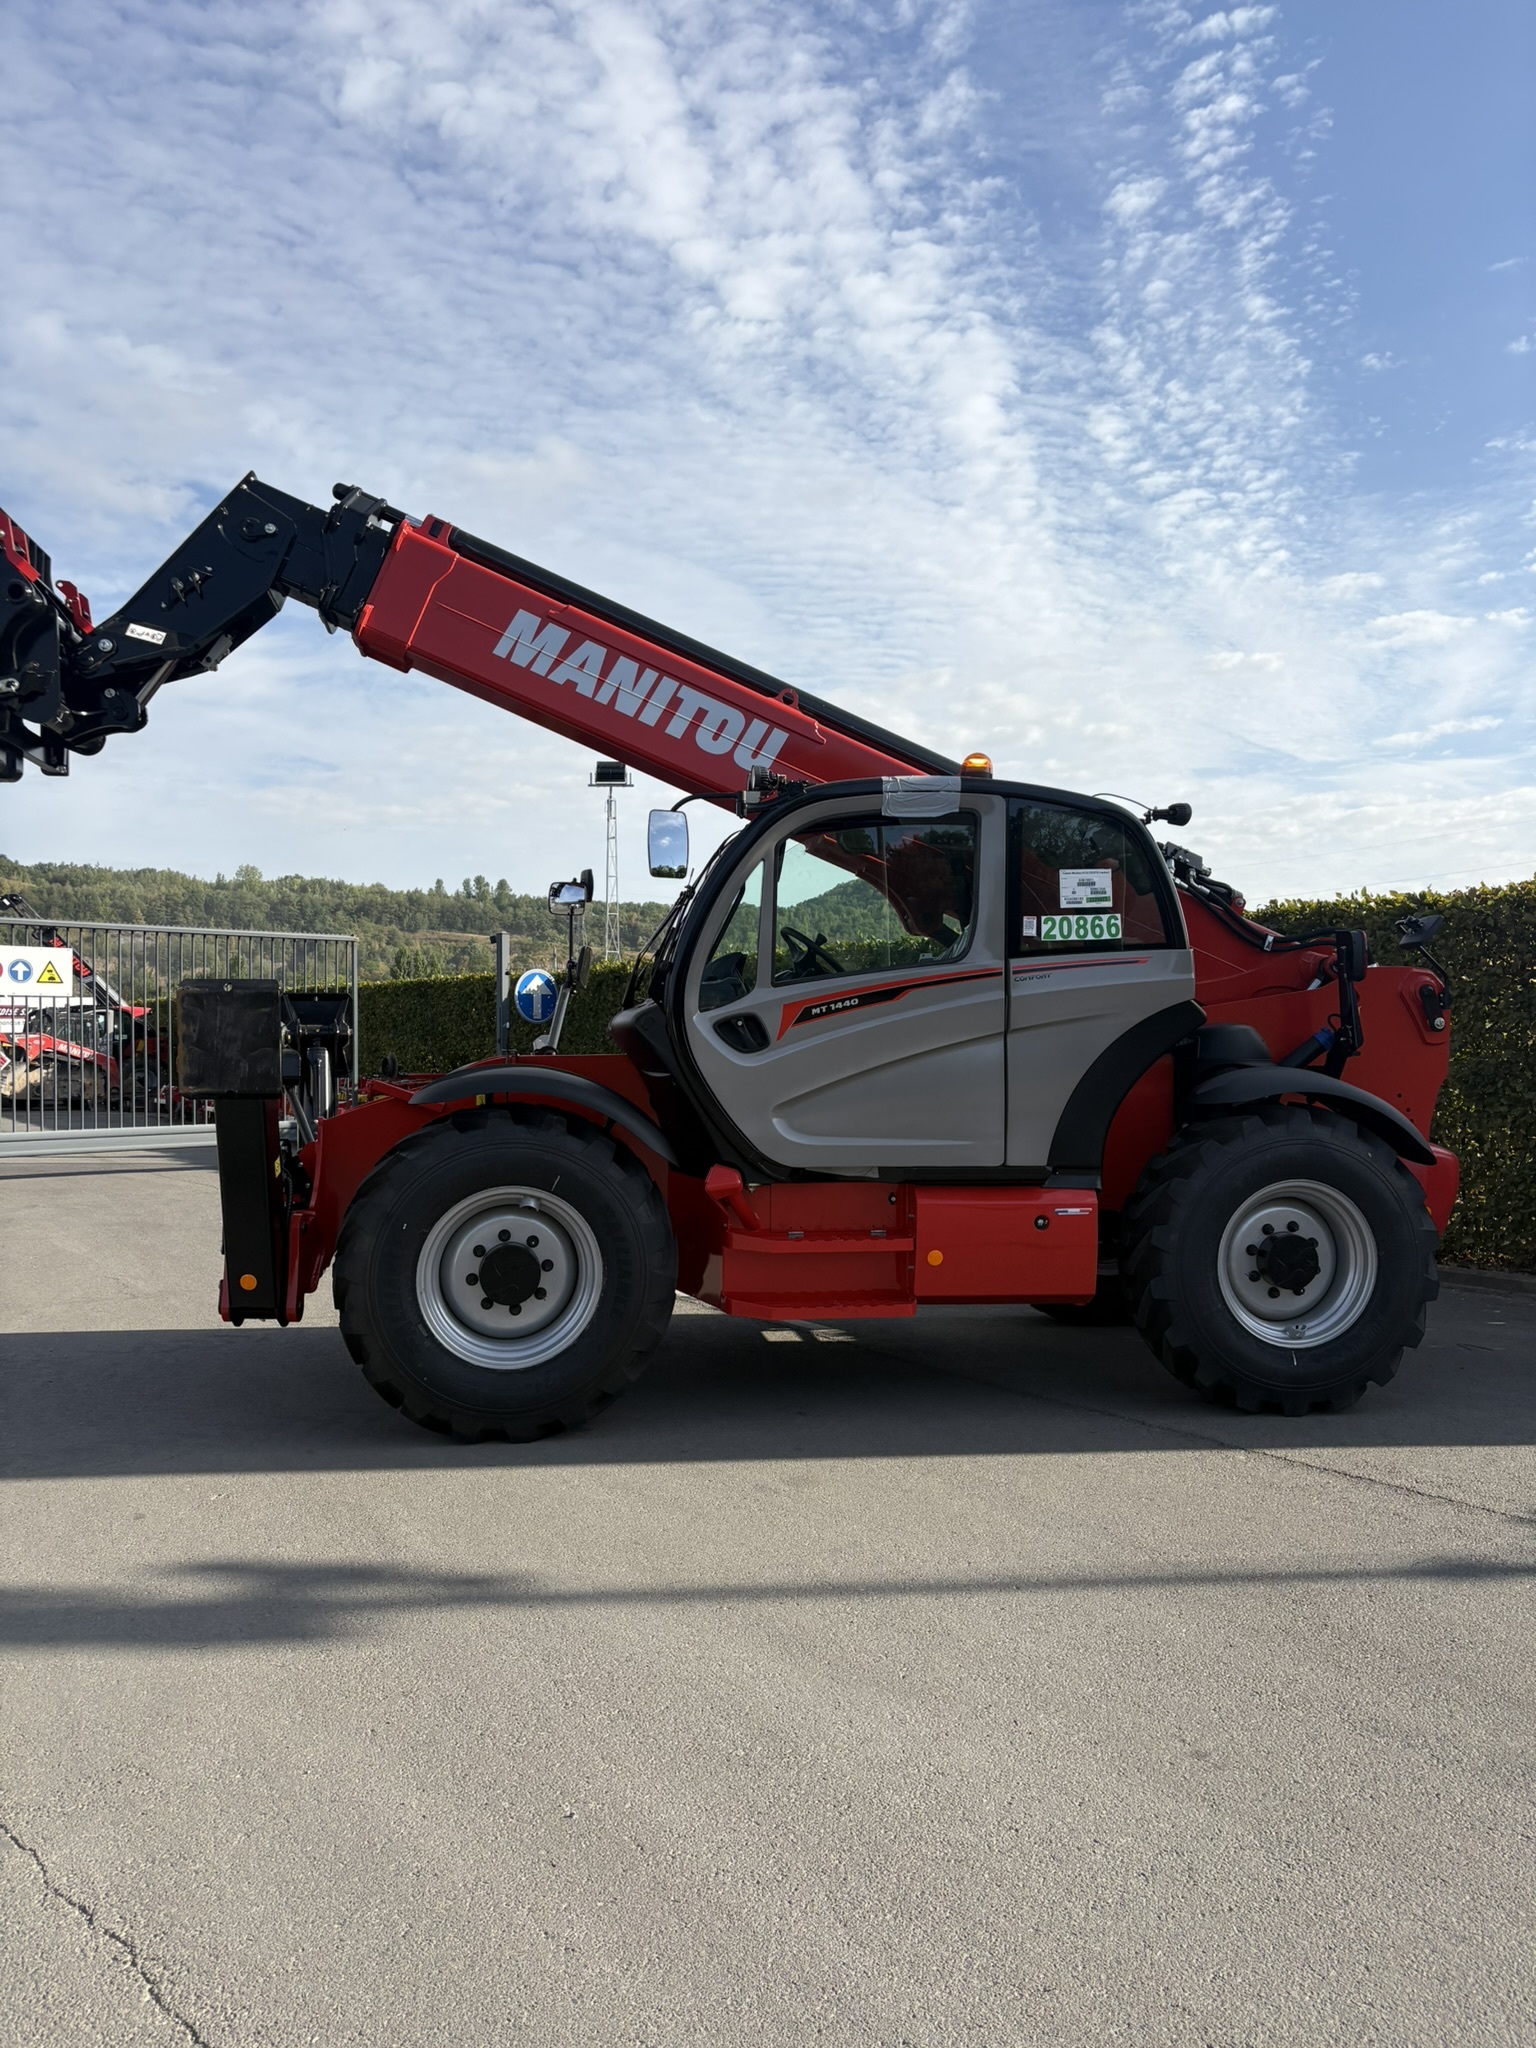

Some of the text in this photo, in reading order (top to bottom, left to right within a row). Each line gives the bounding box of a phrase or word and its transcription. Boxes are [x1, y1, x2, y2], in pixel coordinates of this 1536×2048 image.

[492, 608, 790, 772] MANITOU
[1043, 915, 1120, 939] 20866
[811, 998, 859, 1016] MT 1440
